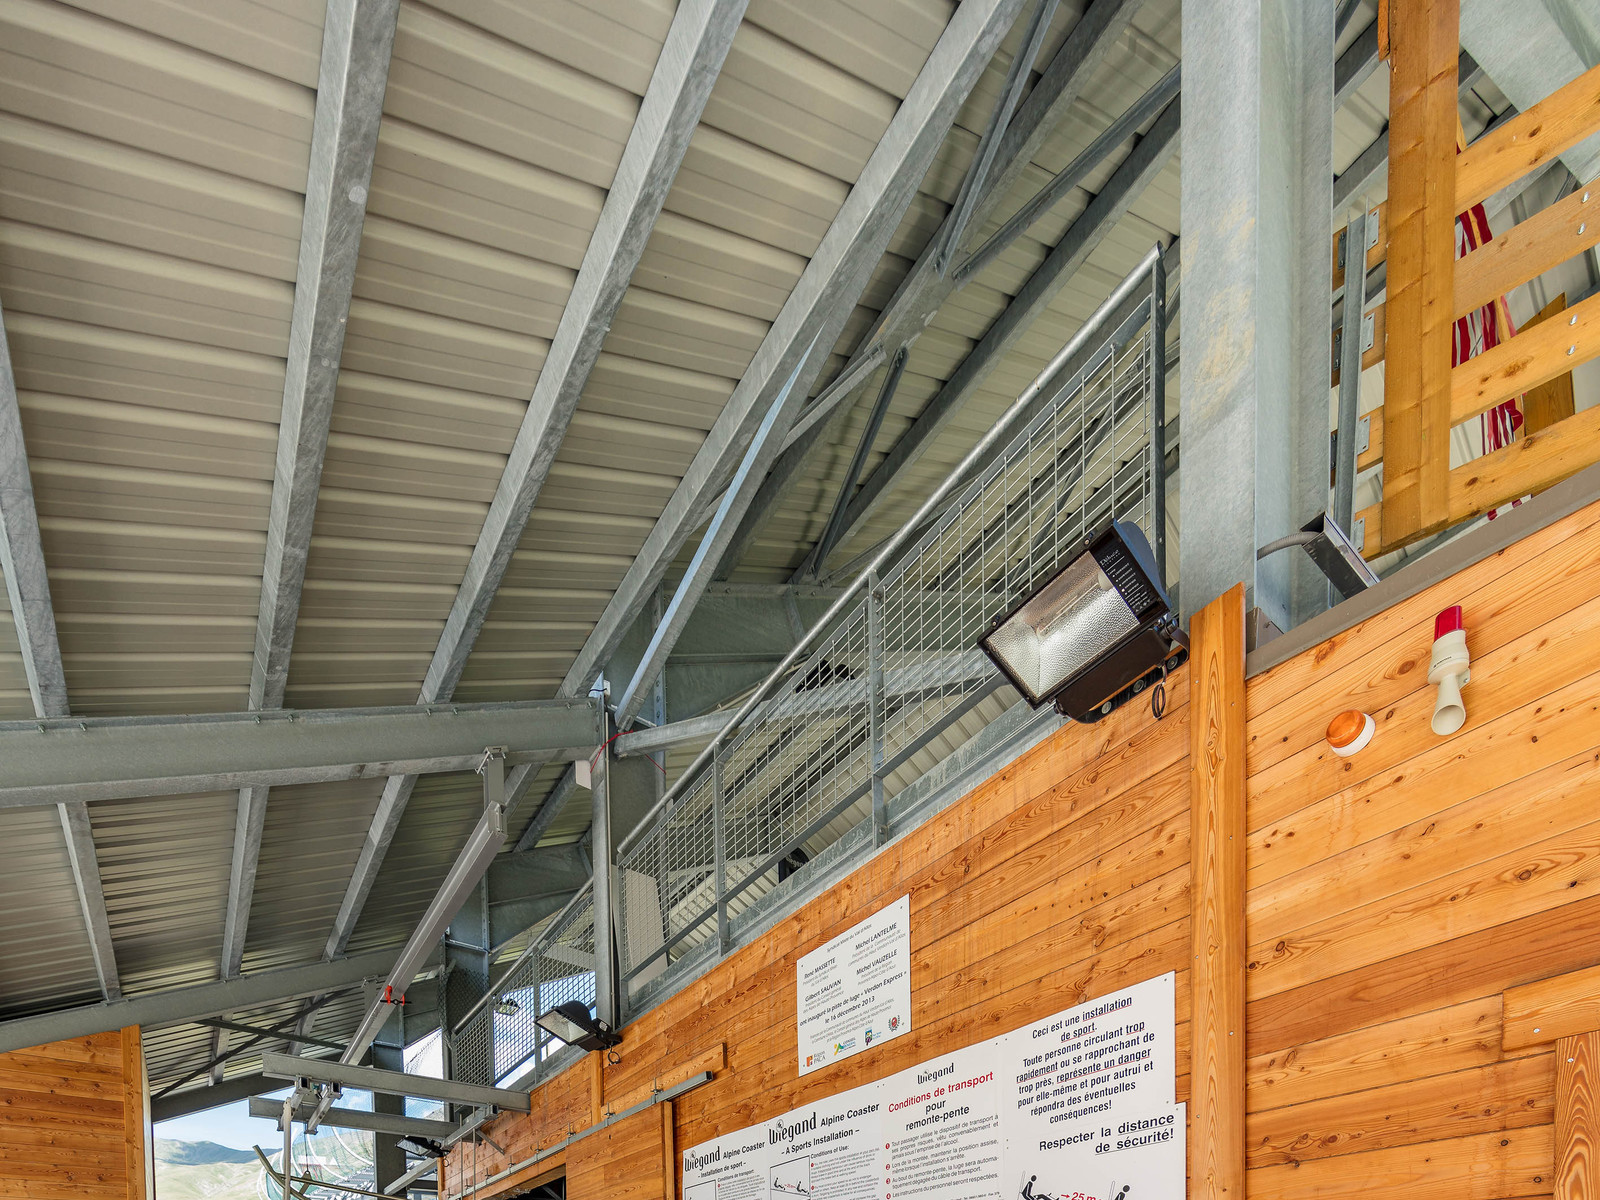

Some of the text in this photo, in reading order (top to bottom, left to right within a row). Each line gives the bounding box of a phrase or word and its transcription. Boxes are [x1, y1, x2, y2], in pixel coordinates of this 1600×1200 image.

[856, 938, 870, 950] Michel
[871, 923, 896, 942] LANTELME
[857, 963, 871, 975] Michel
[872, 949, 897, 967] VAUZELLE
[805, 991, 820, 1002] Gilbert
[821, 979, 841, 994] SAUVAN
[864, 983, 882, 994] Verdon
[884, 972, 903, 985] Express
[862, 996, 875, 1006] 2013
[1033, 997, 1132, 1039] Ceci est une installation
[1023, 1022, 1144, 1067] Toute personne circulant trop
[1061, 1022, 1097, 1042] de sport.
[1017, 1033, 1154, 1084] rapidement ou se rapprochant de
[918, 1063, 954, 1084] Wiegand
[1019, 1049, 1151, 1094] trop près, représente un danger
[889, 1072, 993, 1112] Conditions de transport
[1018, 1061, 1153, 1109] pour elle-même et pour autrui et
[926, 1100, 946, 1115] pour
[1031, 1082, 1135, 1116] répondra des éventuelles
[769, 1104, 879, 1145] Wiegand Alpine Coaster
[906, 1107, 969, 1131] remonte-pente
[1050, 1100, 1111, 1124] conséquences!
[792, 1141, 811, 1153] Sports
[814, 1129, 853, 1145] Installation
[1040, 1114, 1174, 1151] Respecter la distance
[1095, 1128, 1173, 1153] de sécurité!
[685, 1142, 765, 1172] Wiegand Alpine Coaster
[731, 1161, 742, 1170] sport
[811, 1150, 832, 1159] Conditions
